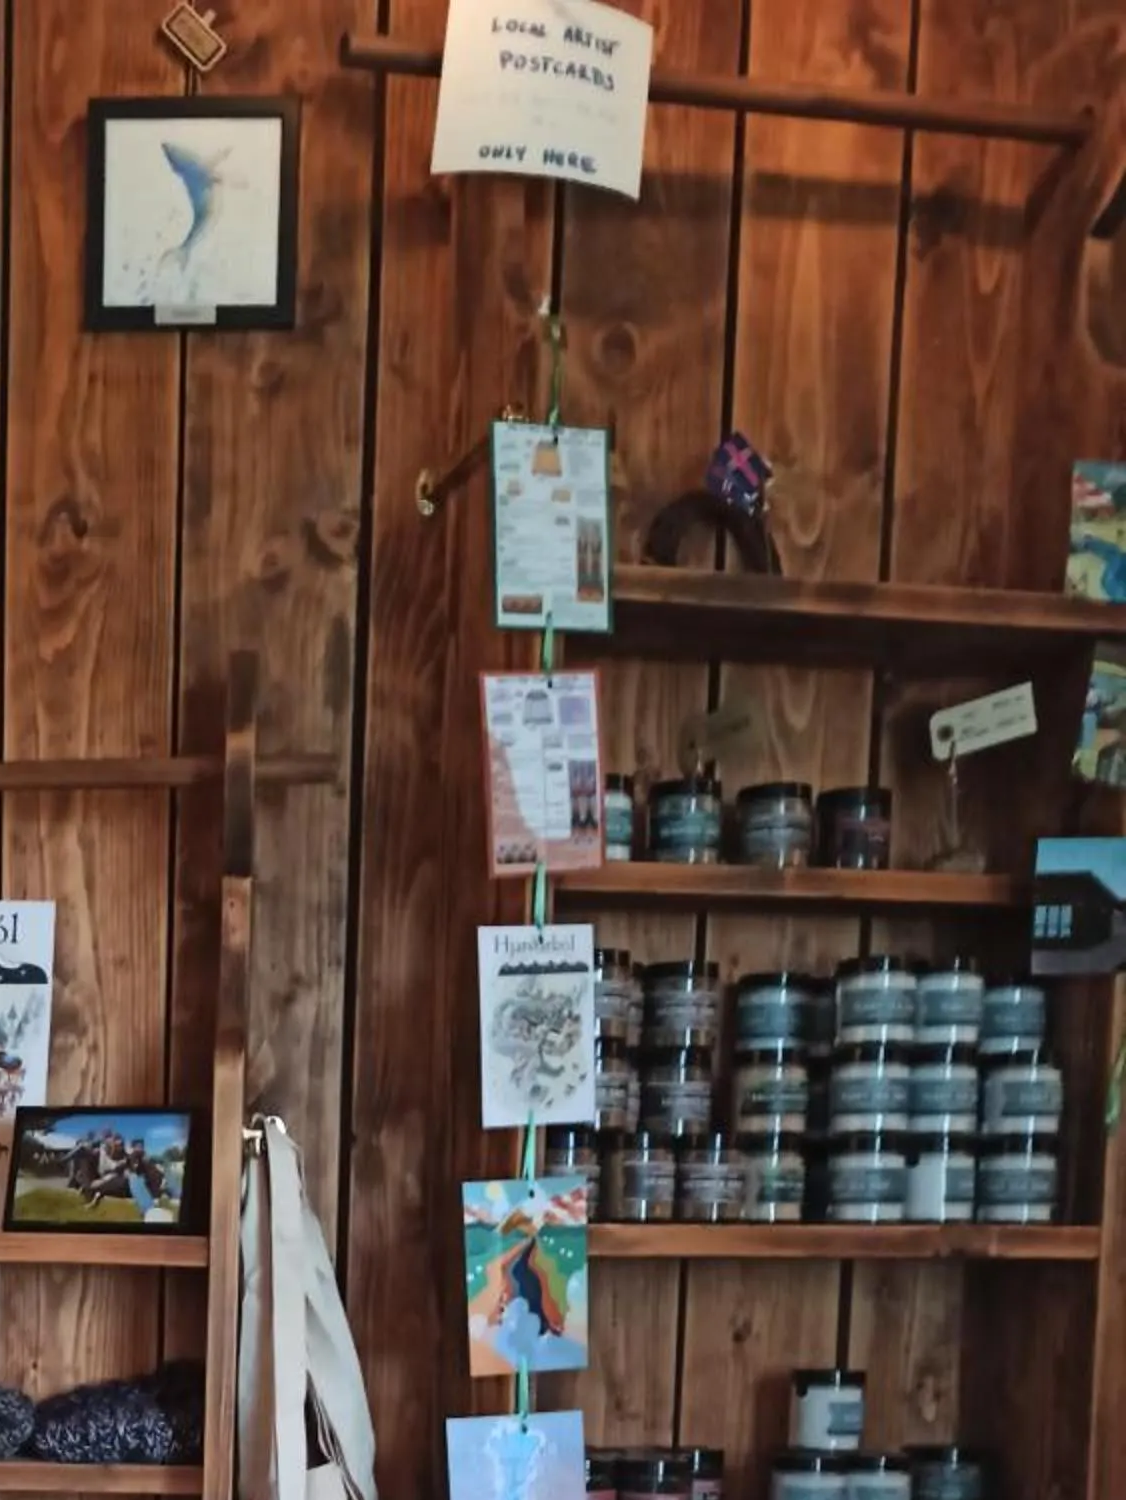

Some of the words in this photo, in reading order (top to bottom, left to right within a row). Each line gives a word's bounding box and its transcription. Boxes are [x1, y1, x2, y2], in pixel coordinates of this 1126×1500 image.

[491, 17, 546, 39] LOCAL
[499, 50, 615, 91] POSTCARDS
[478, 145, 527, 162] ONLY
[543, 149, 597, 174] HERE
